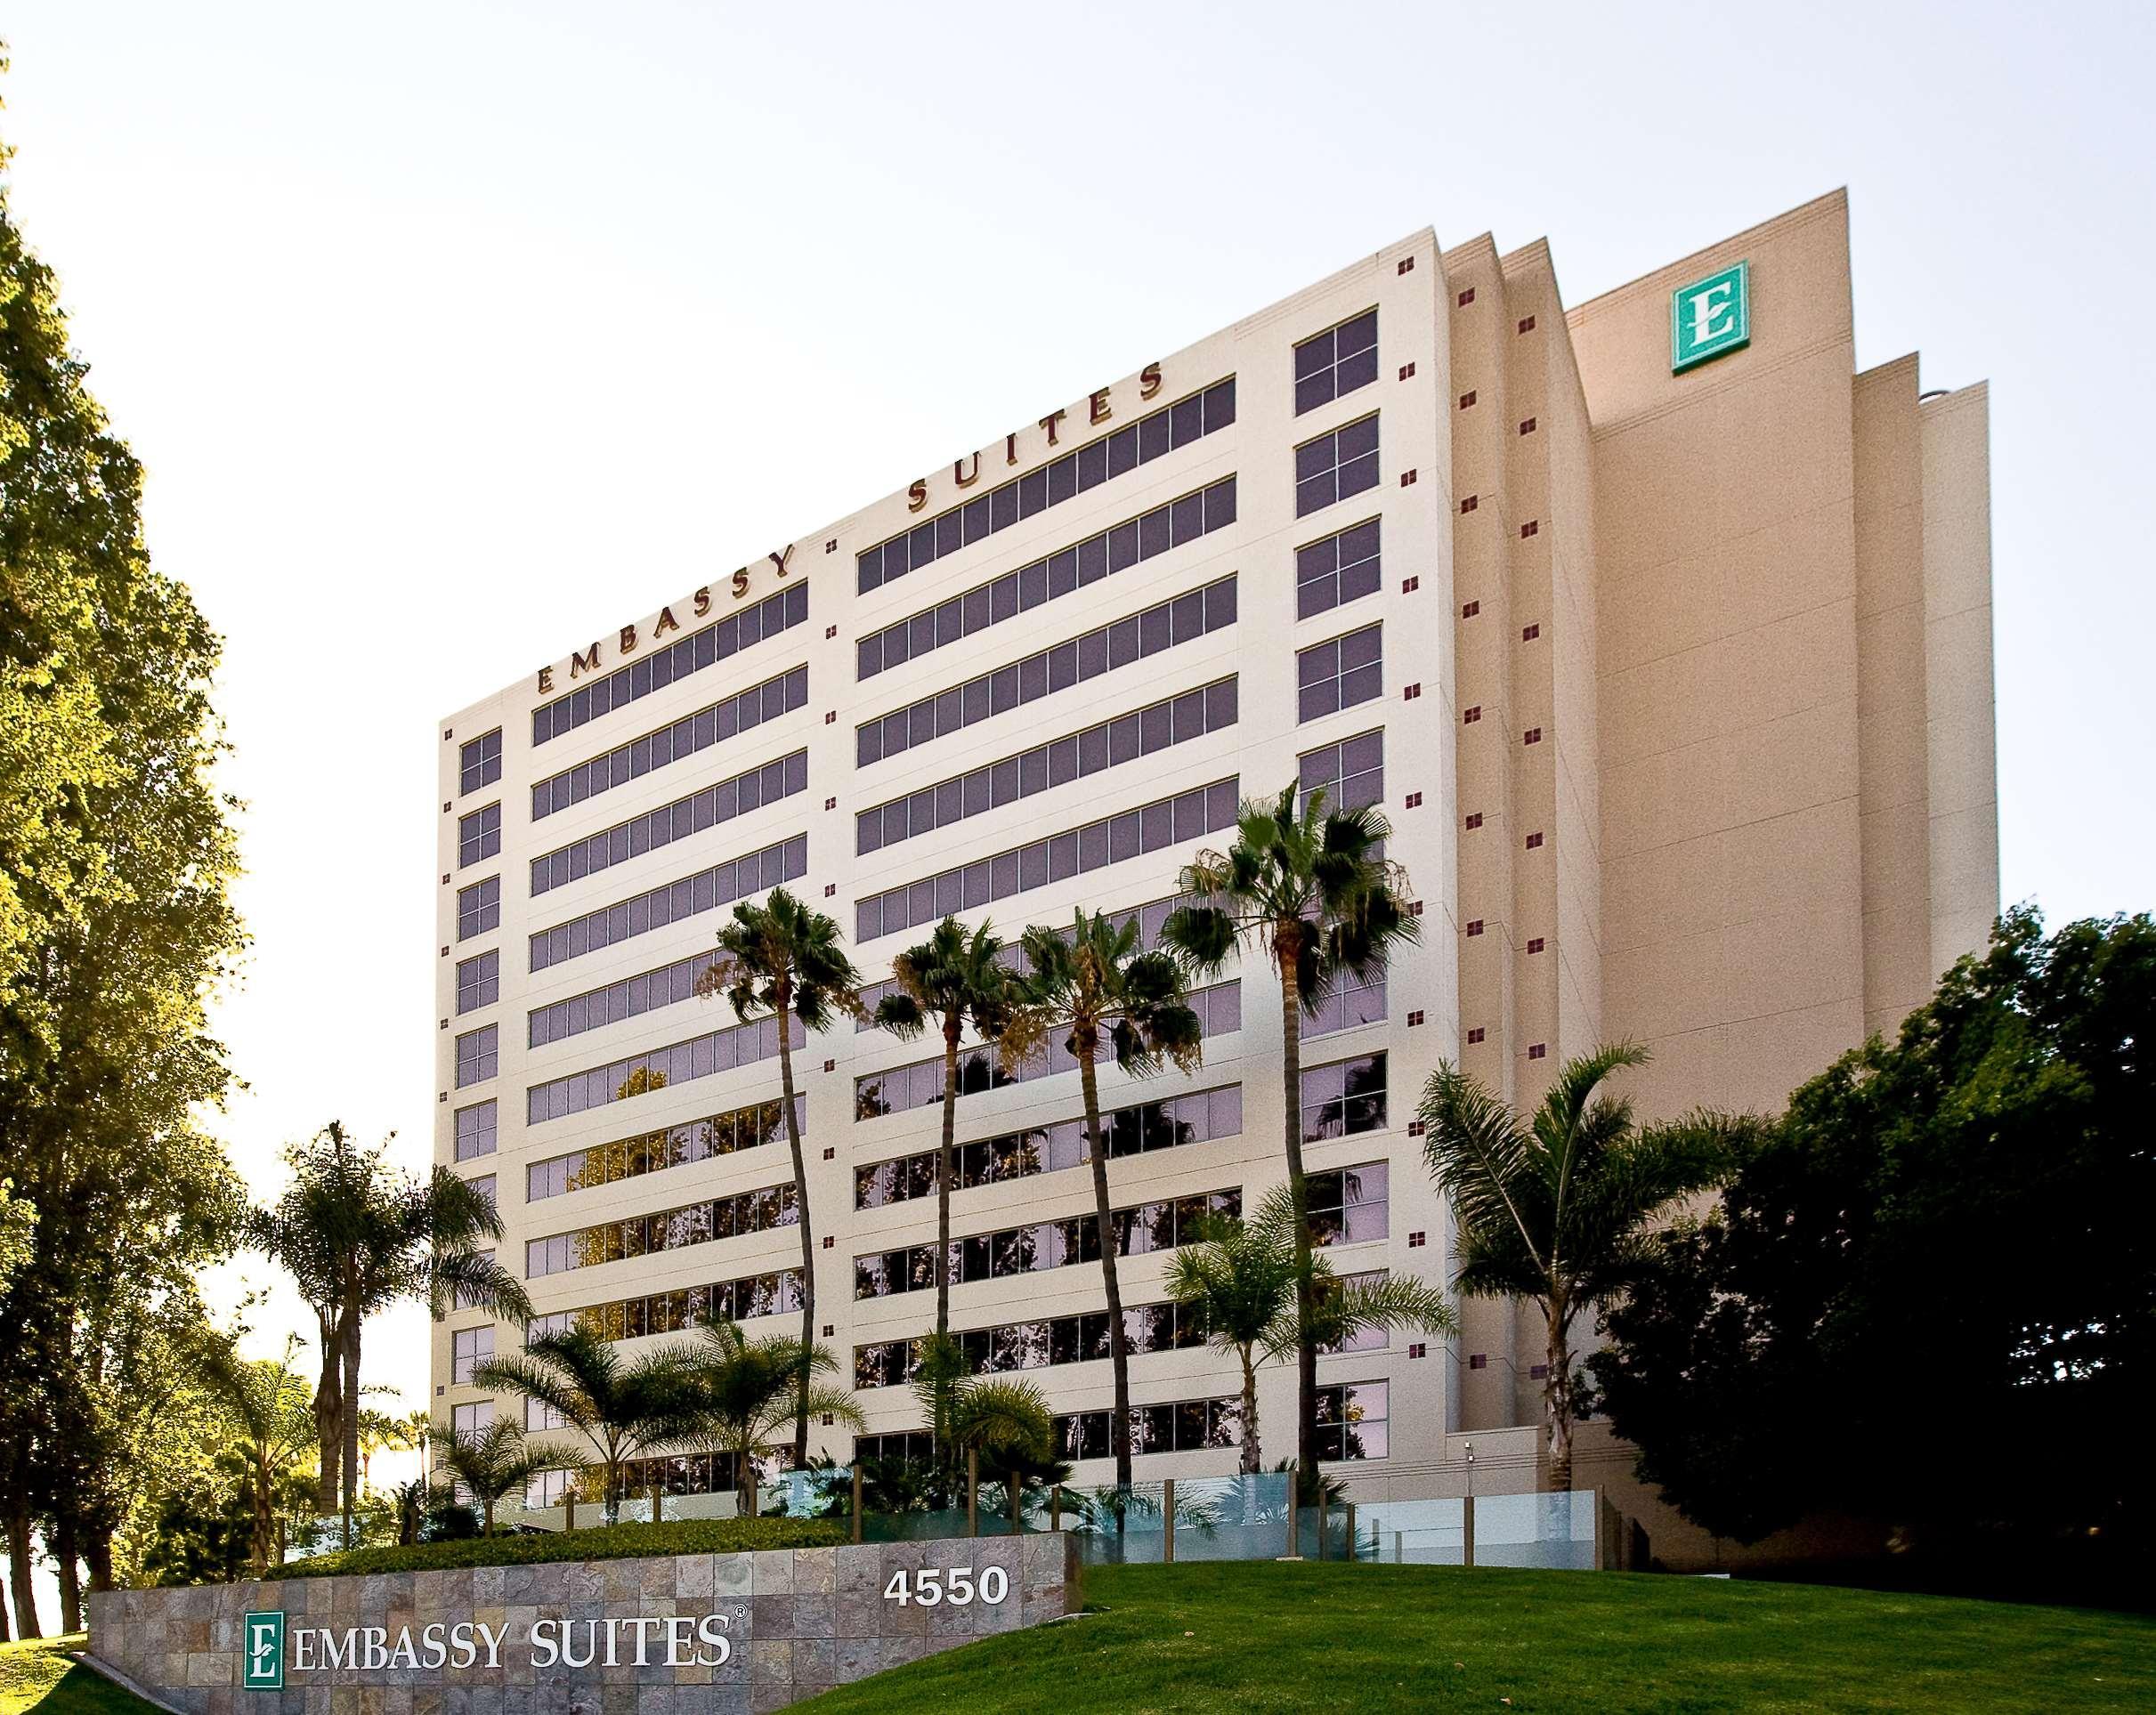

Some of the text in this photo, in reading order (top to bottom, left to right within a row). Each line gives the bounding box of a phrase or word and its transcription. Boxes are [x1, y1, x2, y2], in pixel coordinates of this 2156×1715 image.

[537, 361, 1163, 695] EMBASSY SUITES
[883, 1565, 1009, 1607] 4550
[292, 1622, 510, 1671] EMBASSY
